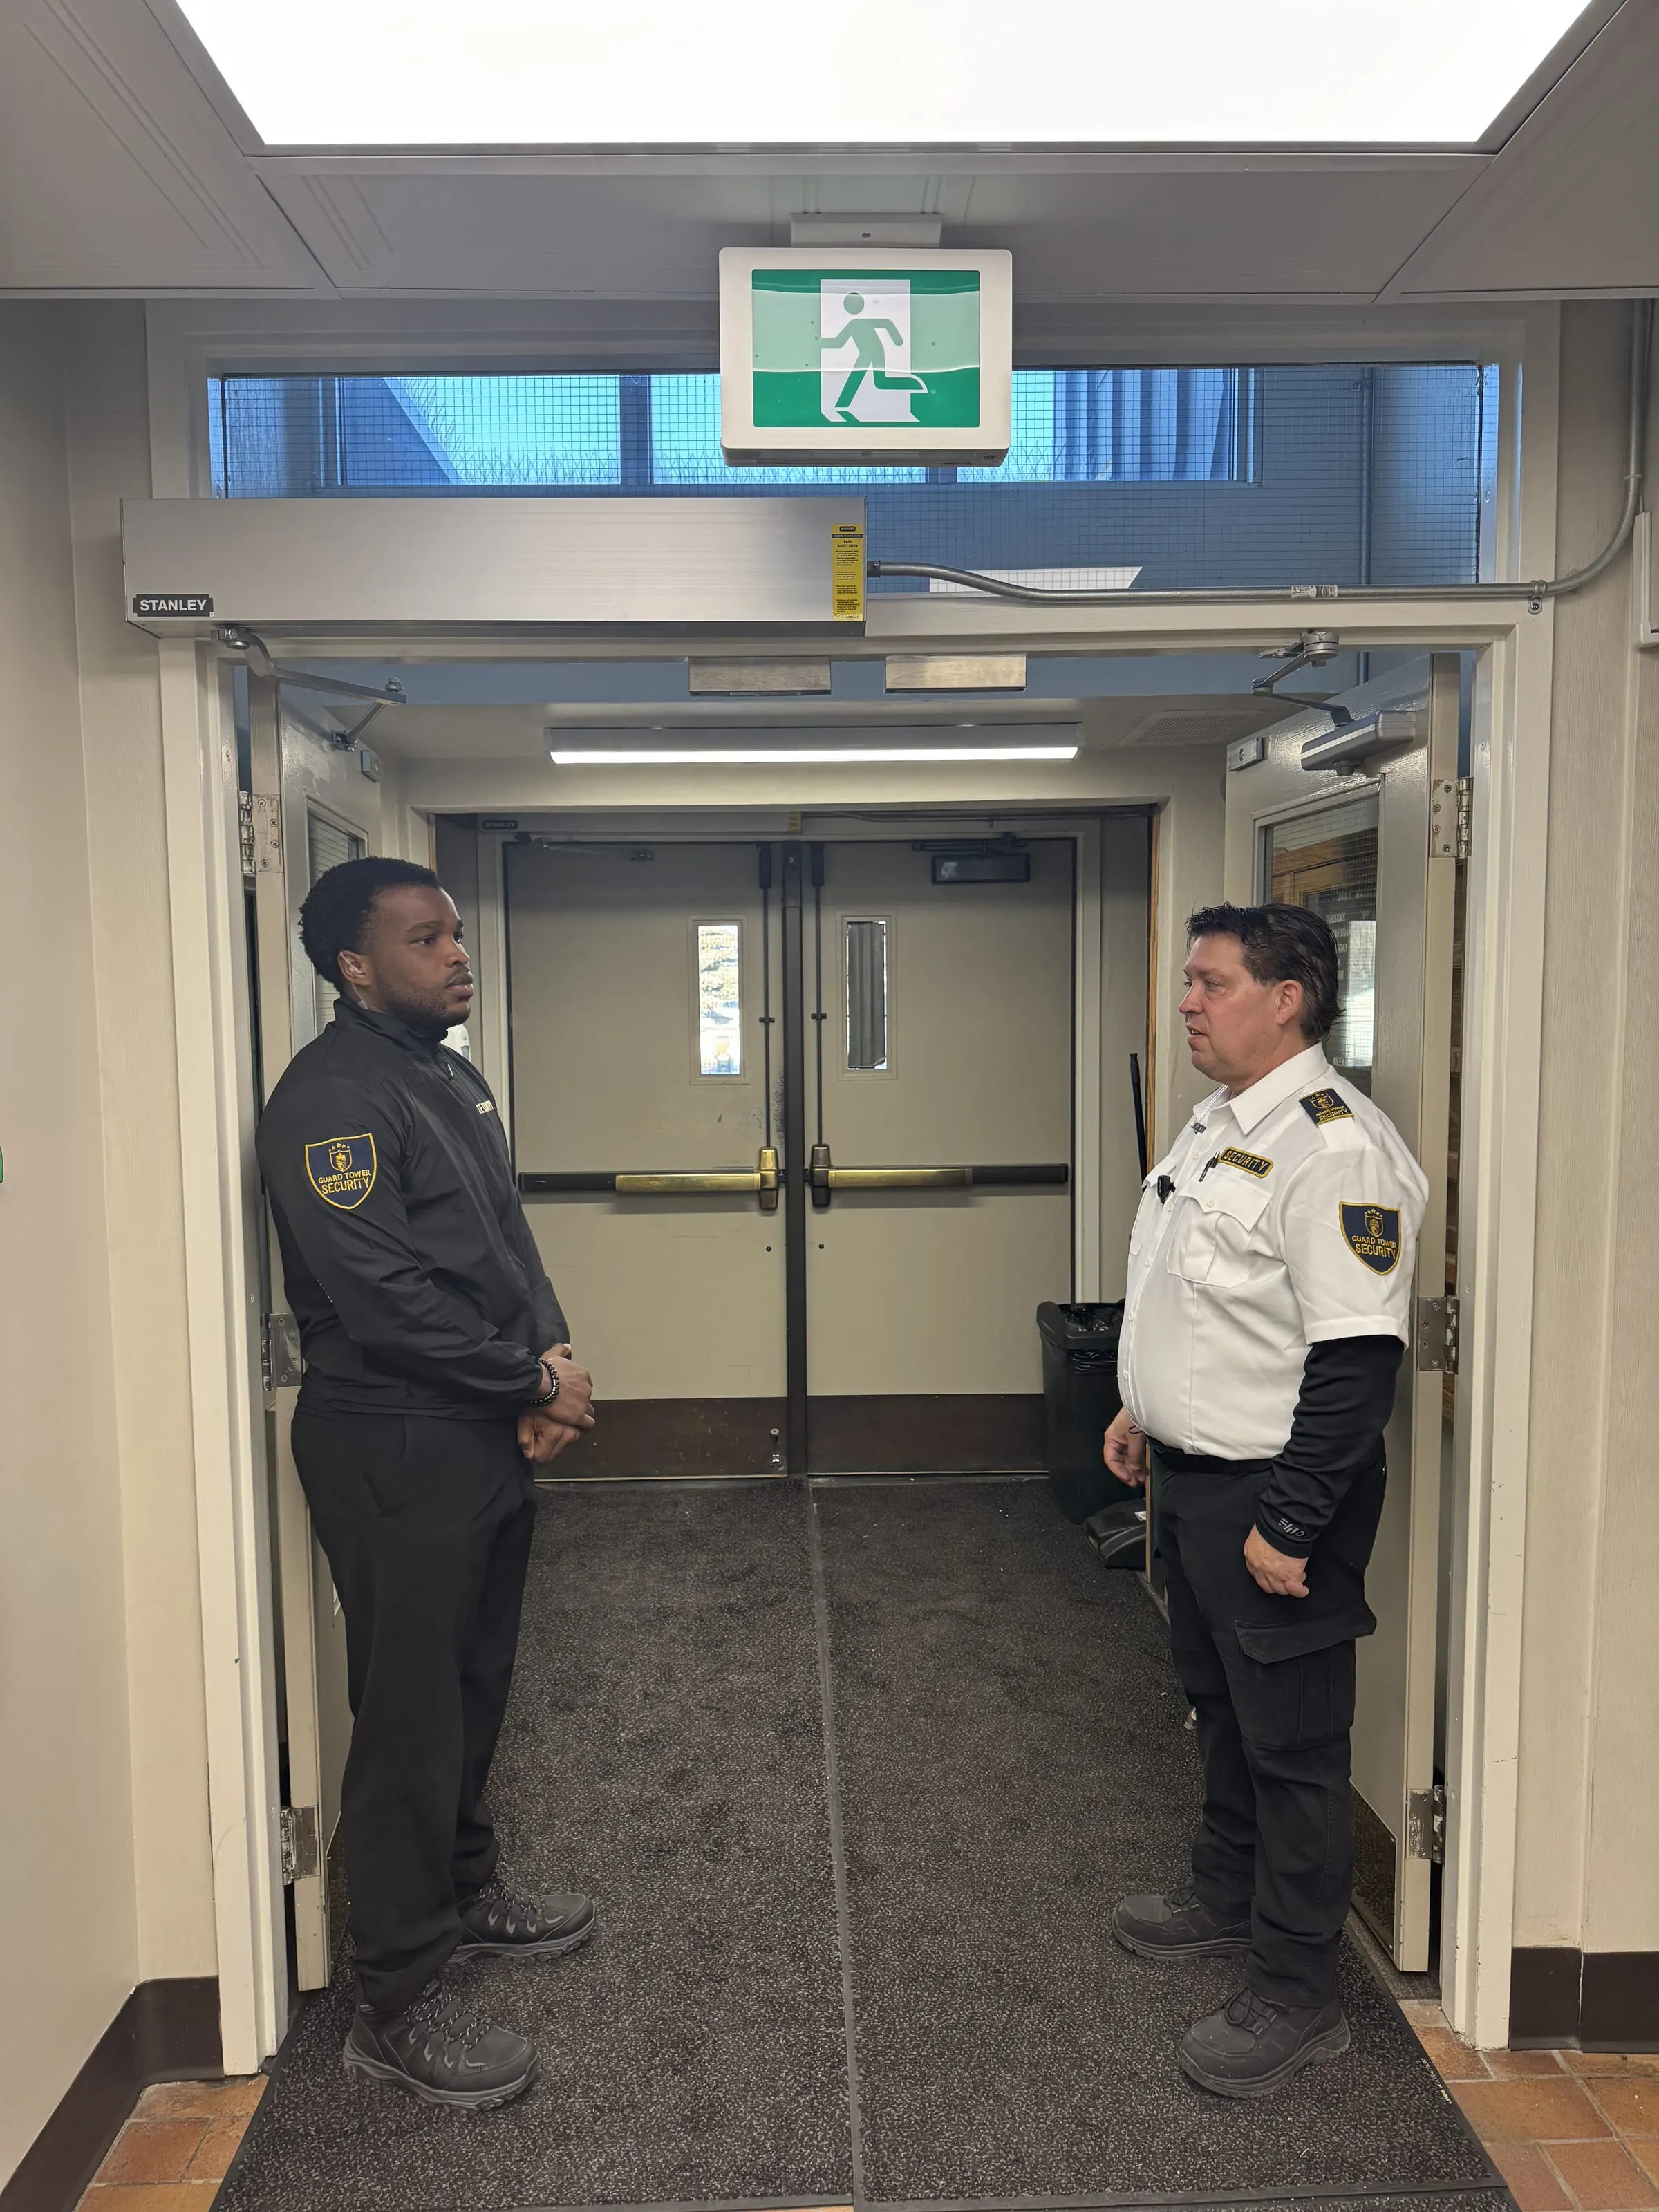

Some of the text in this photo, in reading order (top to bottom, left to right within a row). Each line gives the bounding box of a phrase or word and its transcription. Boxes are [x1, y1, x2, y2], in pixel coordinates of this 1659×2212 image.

[140, 599, 207, 611] STANLEY
[1318, 1108, 1348, 1121] SECURITY
[1224, 1150, 1268, 1173] SECURITY
[318, 1169, 371, 1184] GUARD TOWER
[321, 1177, 371, 1194] SECURITY
[1351, 1235, 1397, 1249] GUARD TOWER
[1355, 1243, 1396, 1259] SECURITY
